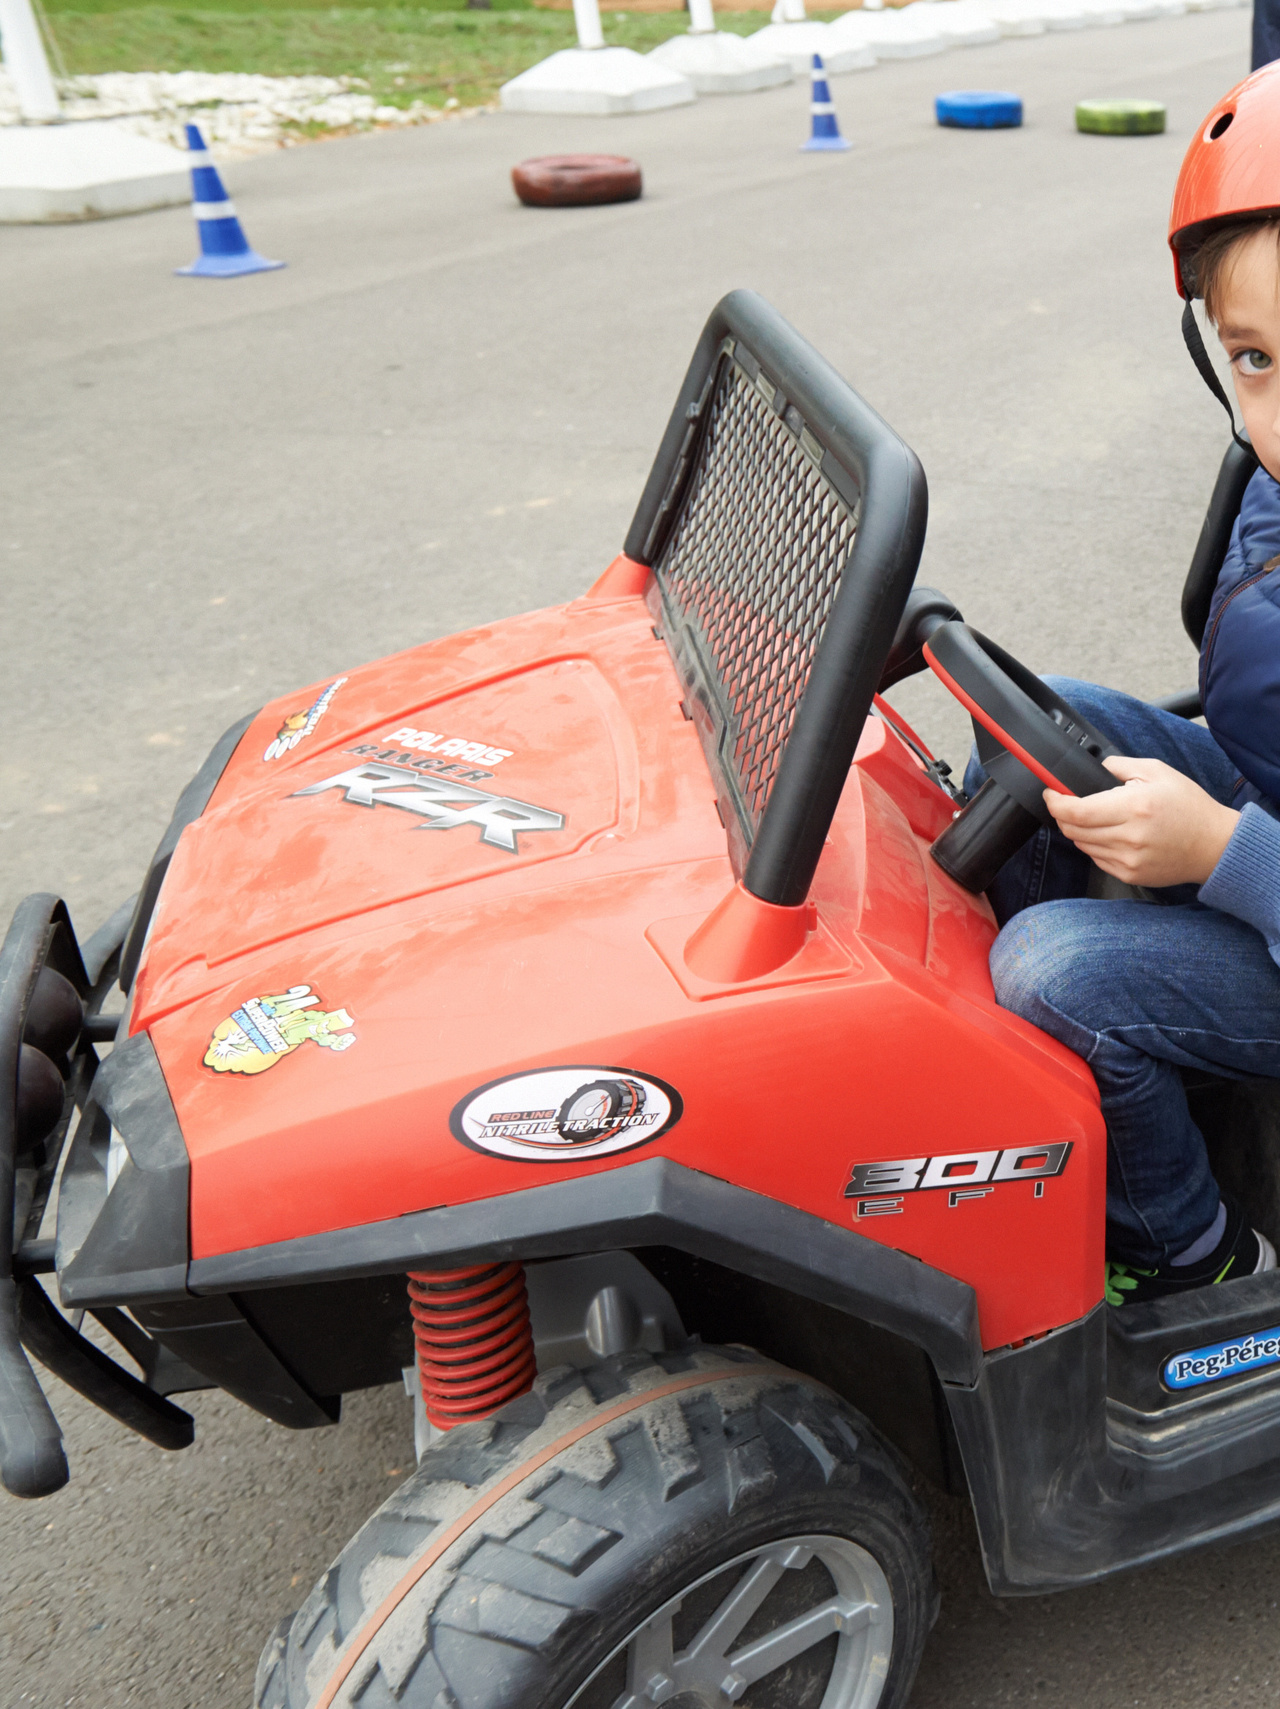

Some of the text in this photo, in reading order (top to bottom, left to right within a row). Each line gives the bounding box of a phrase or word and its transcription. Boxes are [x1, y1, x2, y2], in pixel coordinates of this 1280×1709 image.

[343, 744, 494, 783] RANGER
[382, 727, 514, 766] POLARIS
[285, 761, 566, 855] RZR
[479, 1113, 660, 1138] NITRILE TRACTION
[490, 1110, 556, 1122] RED LINE
[843, 1141, 1075, 1198] 800
